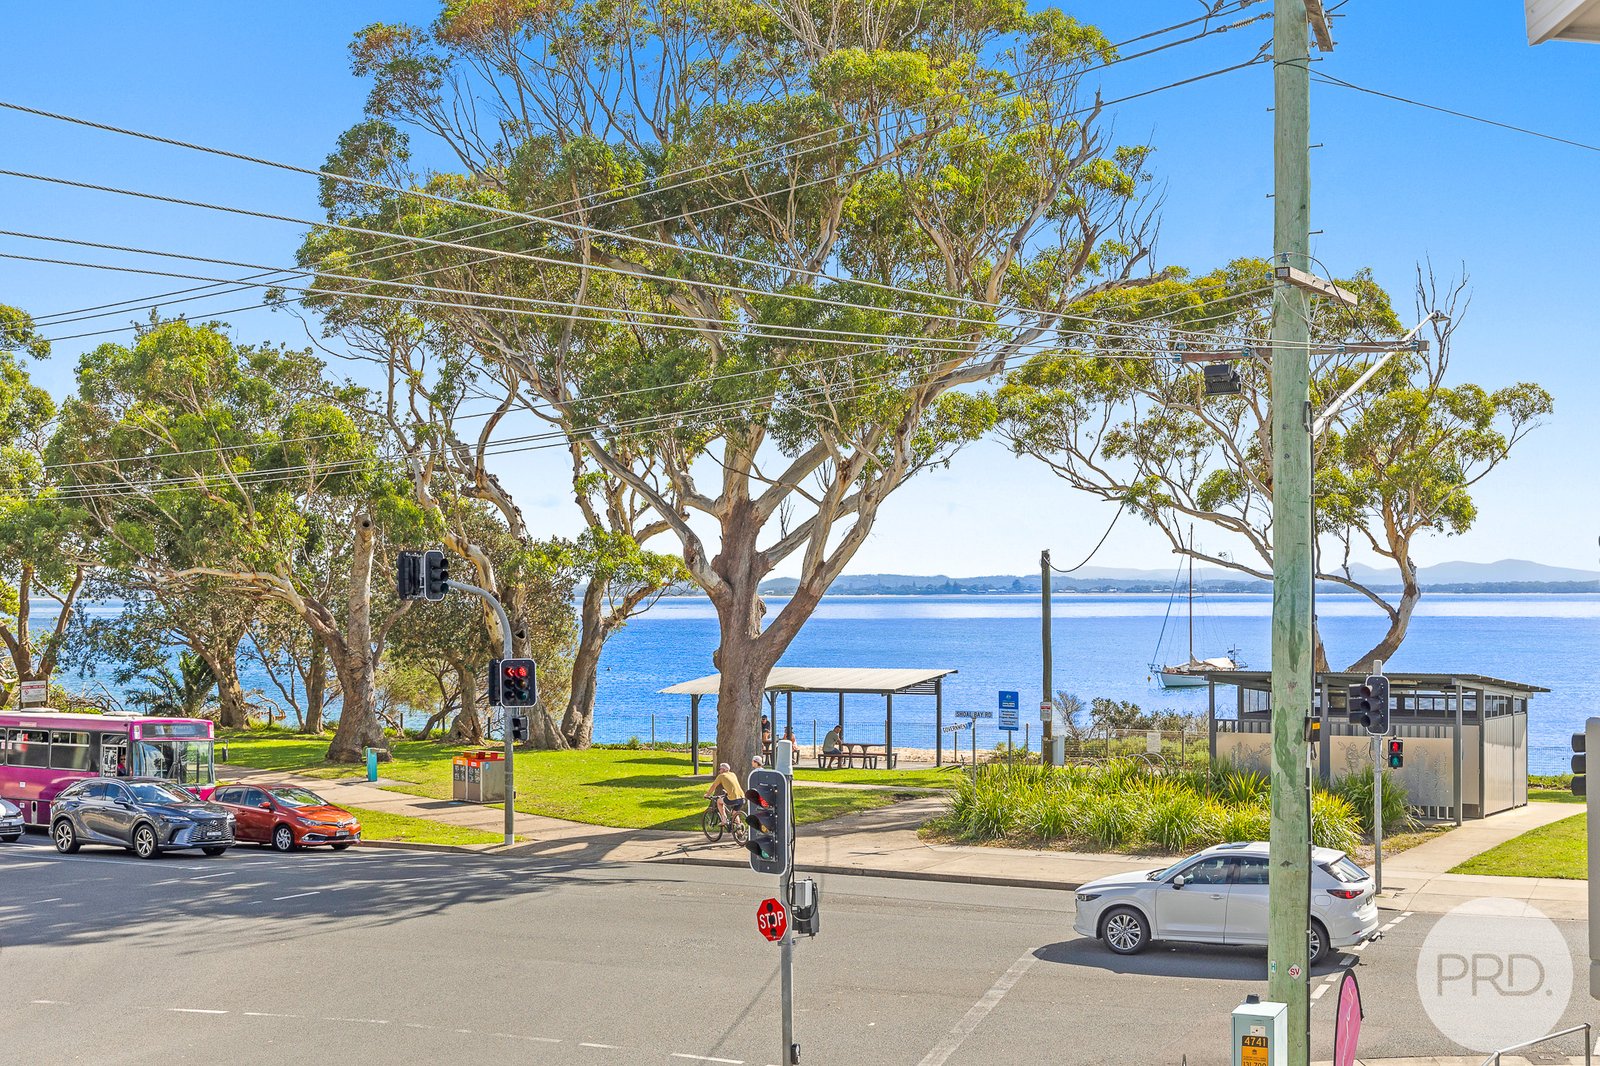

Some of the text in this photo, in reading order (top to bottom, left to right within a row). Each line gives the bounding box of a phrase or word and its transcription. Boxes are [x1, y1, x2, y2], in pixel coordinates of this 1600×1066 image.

[759, 911, 784, 929] STOP
[1290, 968, 1300, 976] SV
[1244, 1037, 1266, 1047] 4741
